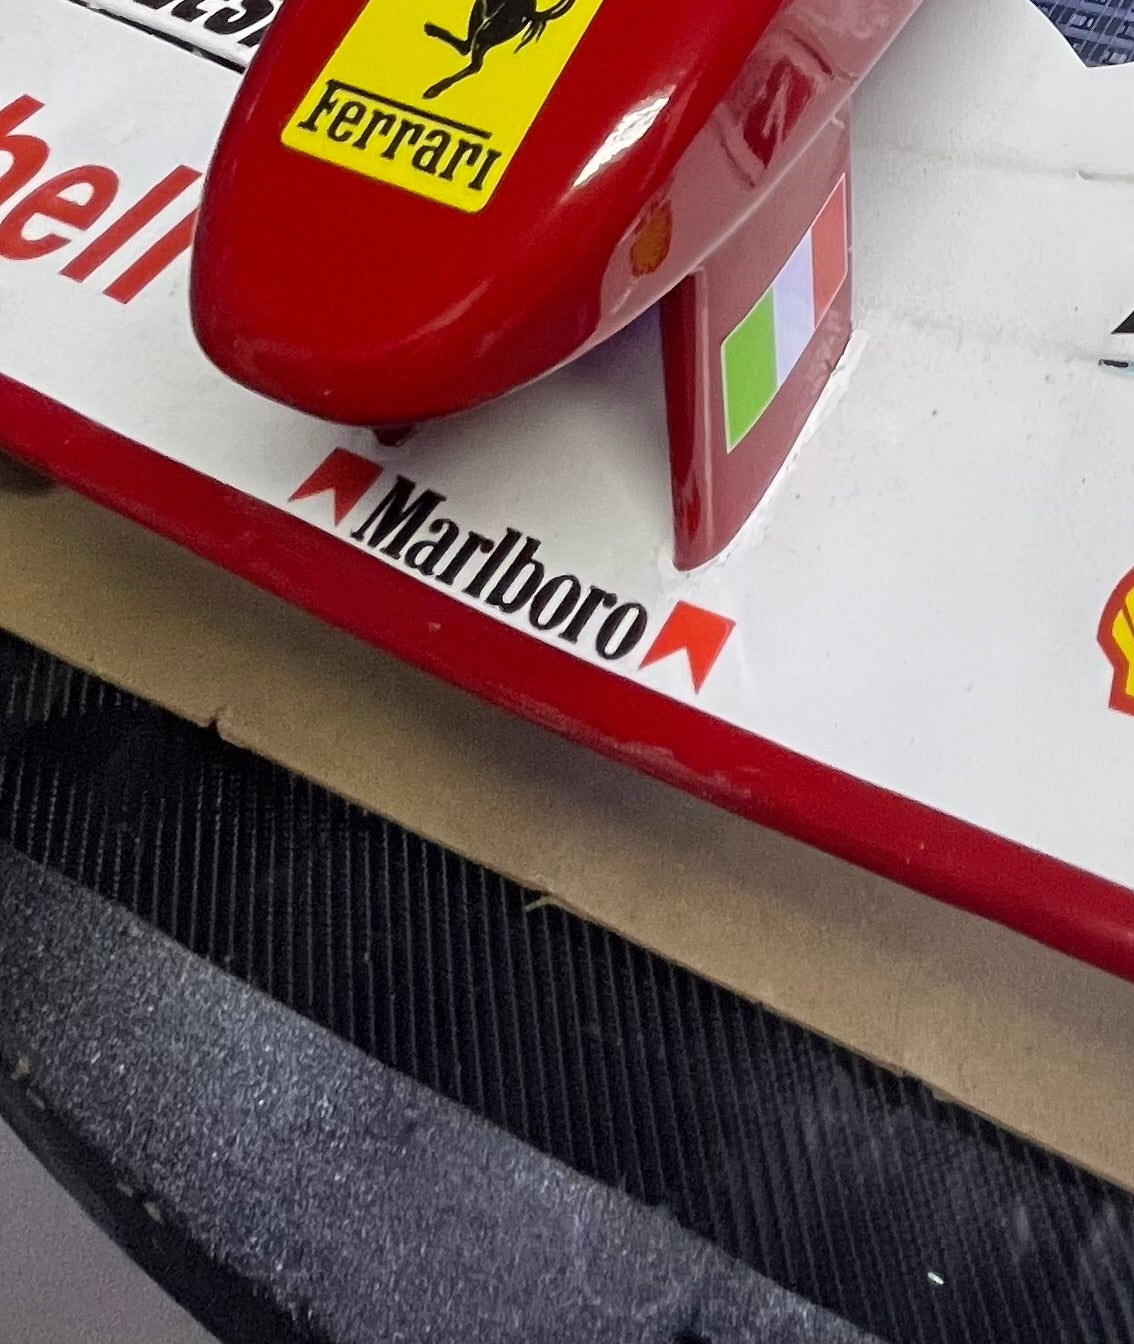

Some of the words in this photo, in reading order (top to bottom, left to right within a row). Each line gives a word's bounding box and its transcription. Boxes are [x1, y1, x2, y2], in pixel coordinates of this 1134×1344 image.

[0, 94, 203, 304] hell
[298, 80, 503, 193] Ferrari
[349, 474, 649, 660] Marlboro
